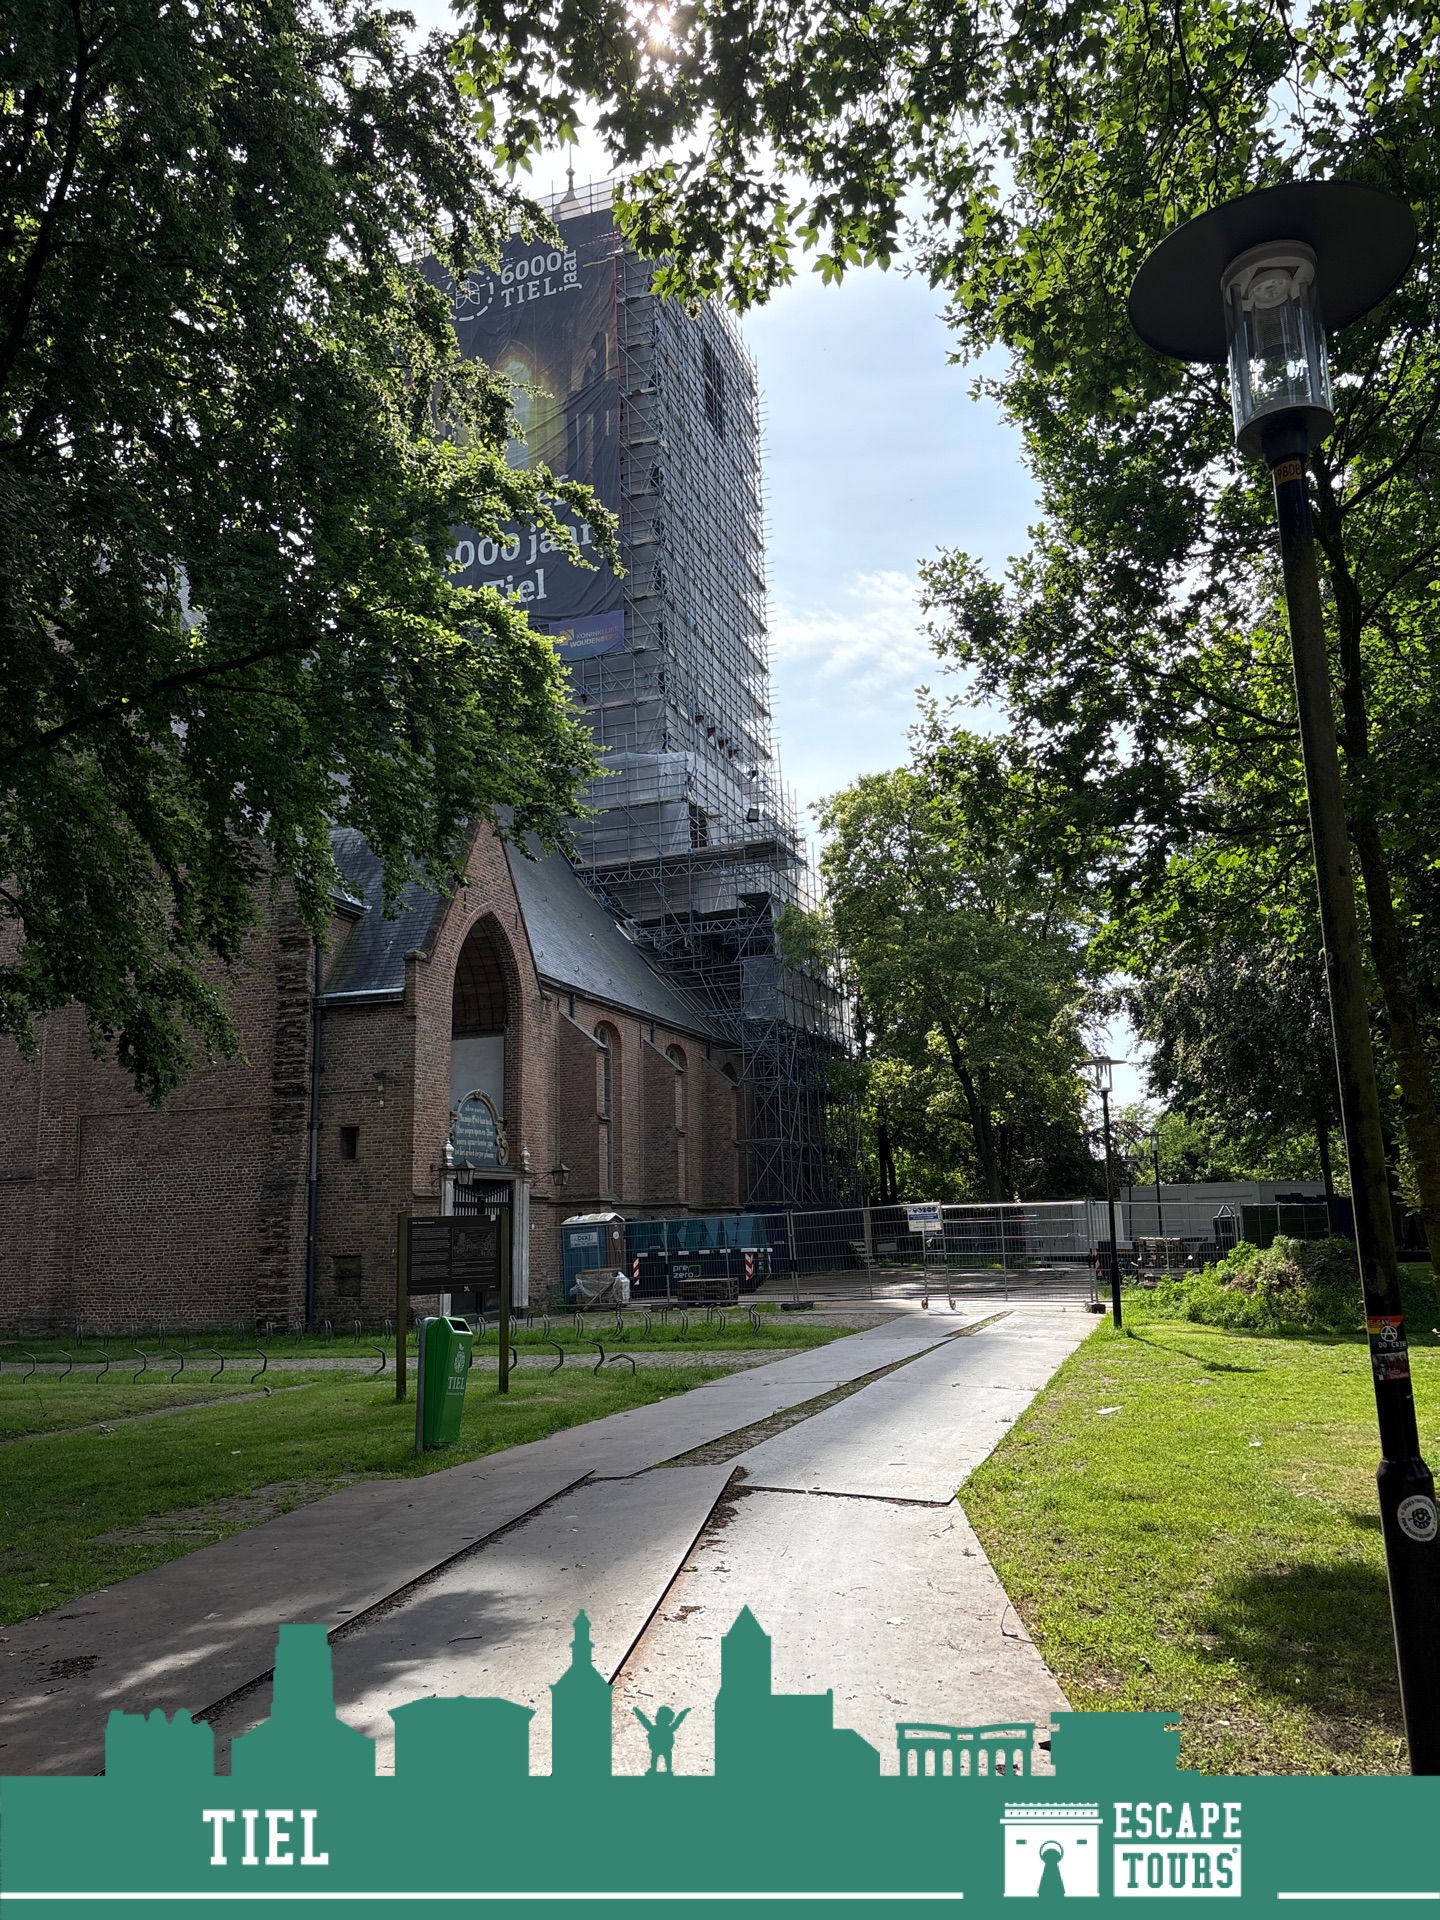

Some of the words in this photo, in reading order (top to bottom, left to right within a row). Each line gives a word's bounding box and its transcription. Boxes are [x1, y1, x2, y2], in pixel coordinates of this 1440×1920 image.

[500, 251, 562, 286] 6000
[559, 245, 583, 292] jaar
[500, 276, 557, 308] TIEL
[482, 568, 548, 604] Tiel
[672, 1265, 688, 1273] pre
[448, 1376, 465, 1390] TIEL
